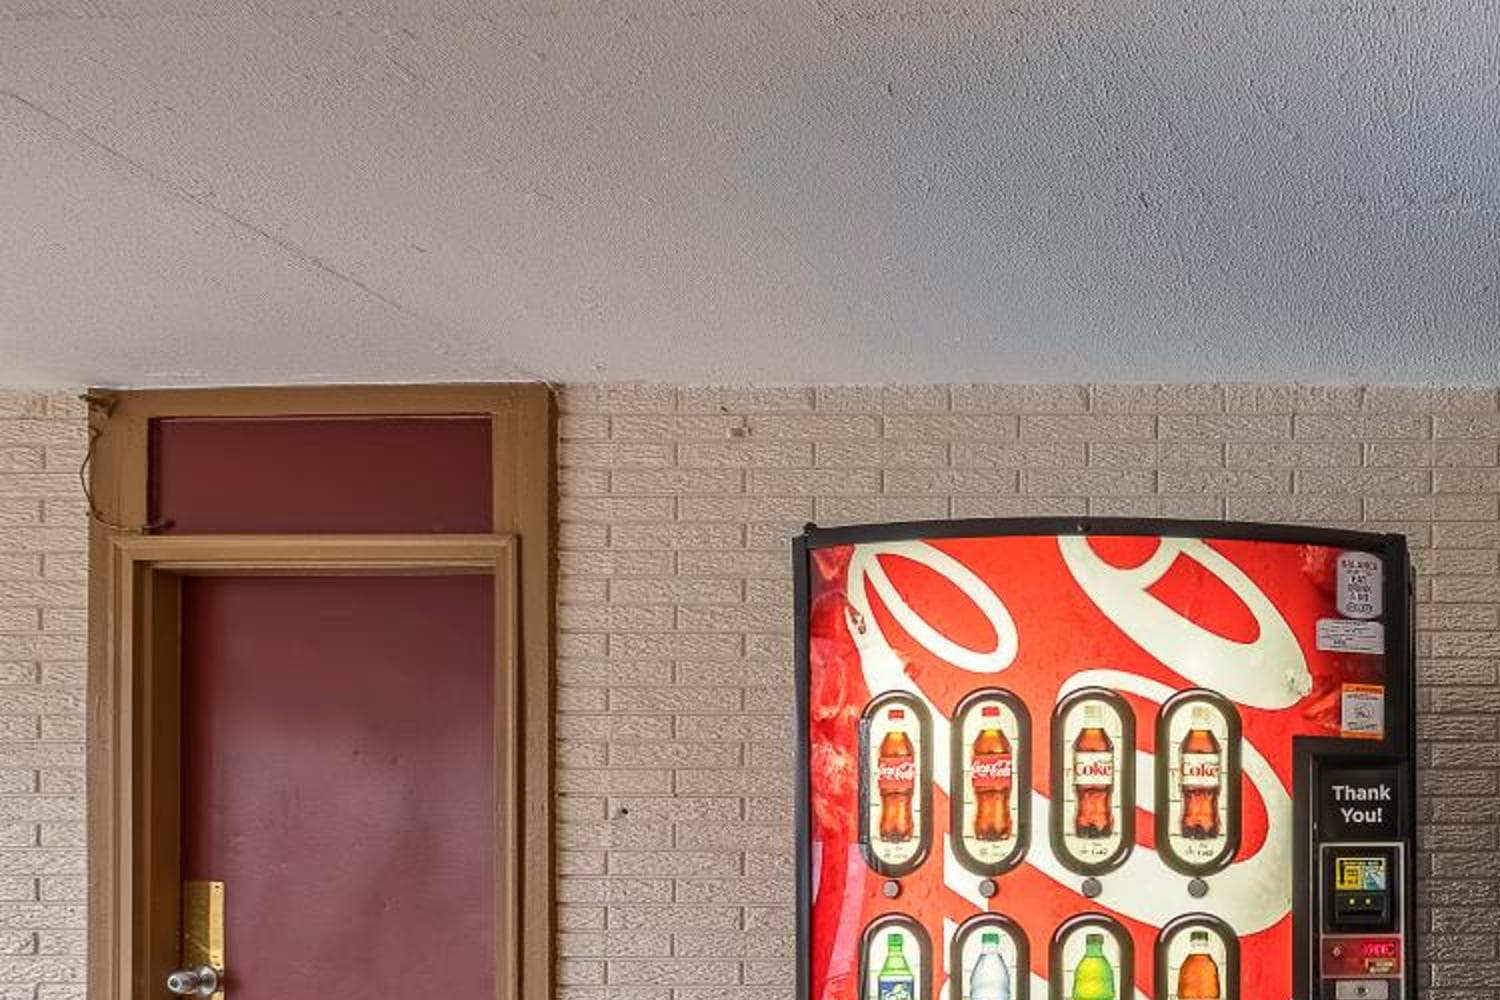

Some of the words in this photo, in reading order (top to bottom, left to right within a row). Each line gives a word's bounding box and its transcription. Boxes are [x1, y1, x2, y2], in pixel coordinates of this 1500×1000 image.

[1073, 761, 1113, 777] Coke
[1181, 763, 1220, 777] Coke
[1331, 784, 1392, 801] Thank
[1340, 807, 1383, 823] You!
